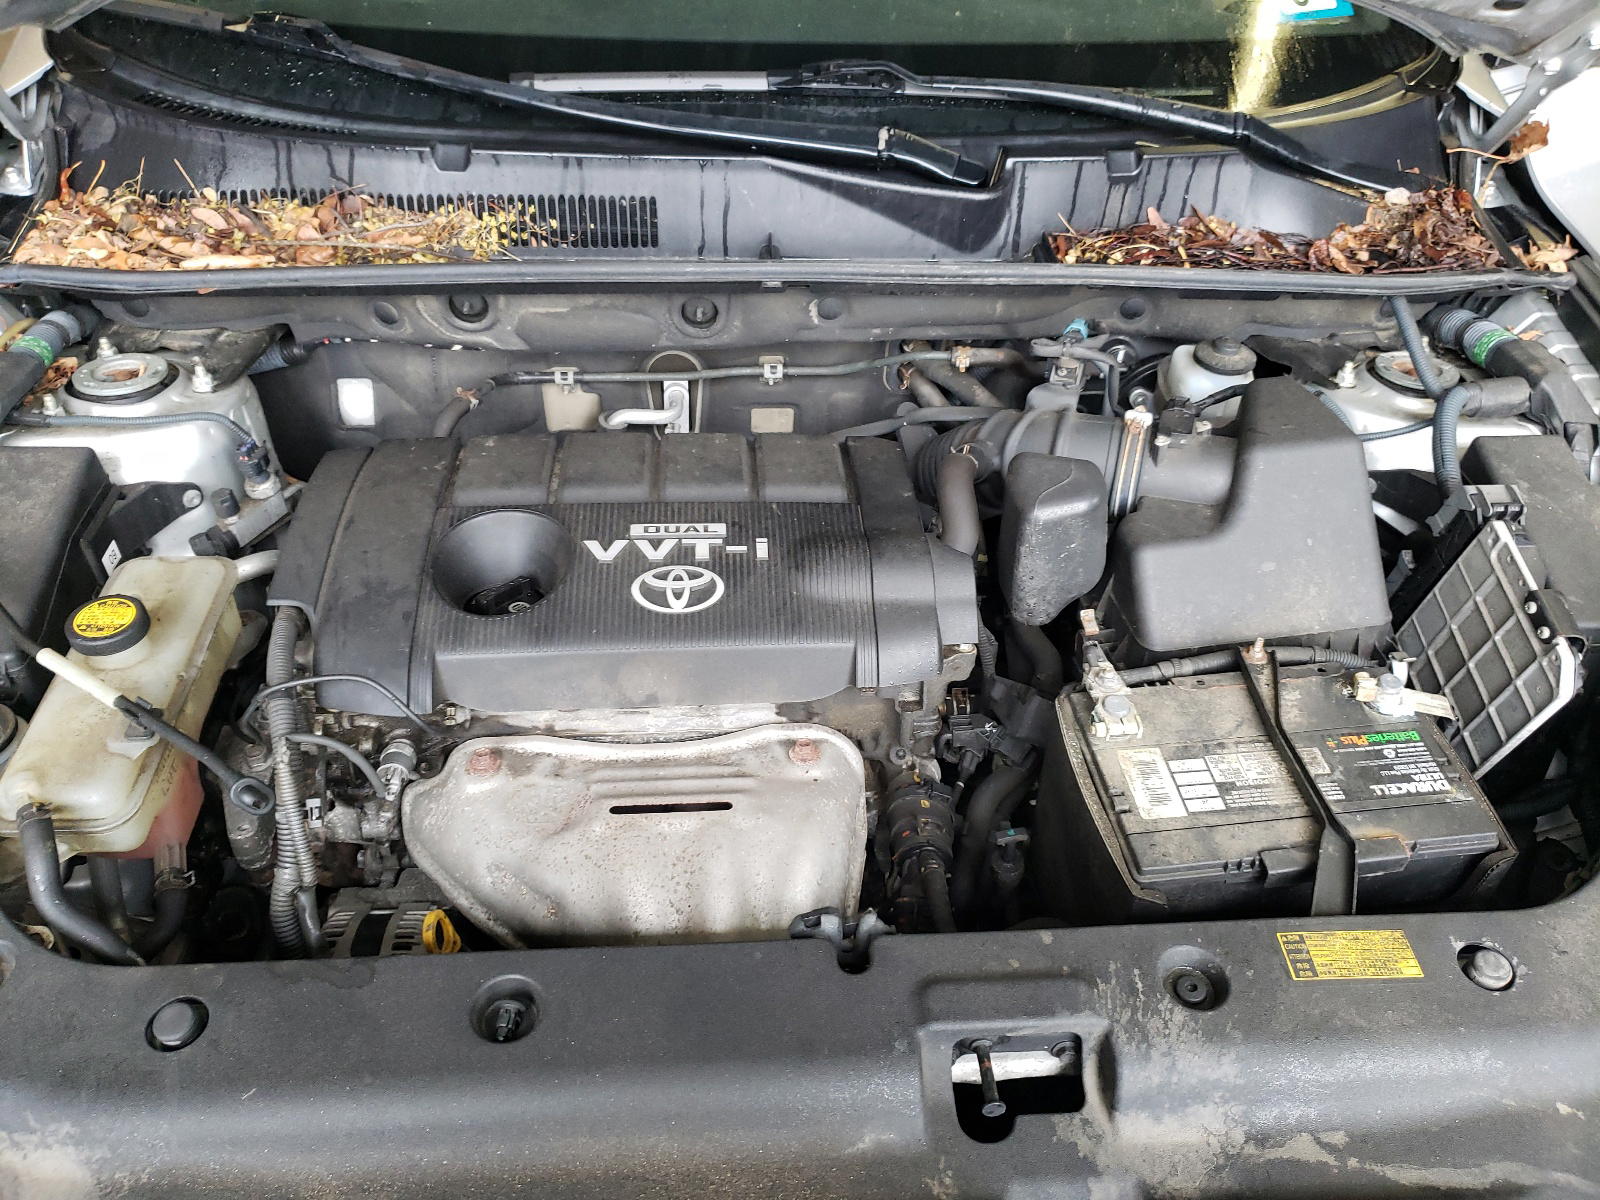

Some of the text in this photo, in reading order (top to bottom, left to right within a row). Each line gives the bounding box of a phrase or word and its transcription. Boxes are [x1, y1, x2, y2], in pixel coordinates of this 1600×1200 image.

[643, 524, 719, 534] DUAL
[582, 537, 769, 563] VVT-i
[1410, 772, 1445, 782] ULTRA
[1369, 779, 1453, 796] DURACELL
